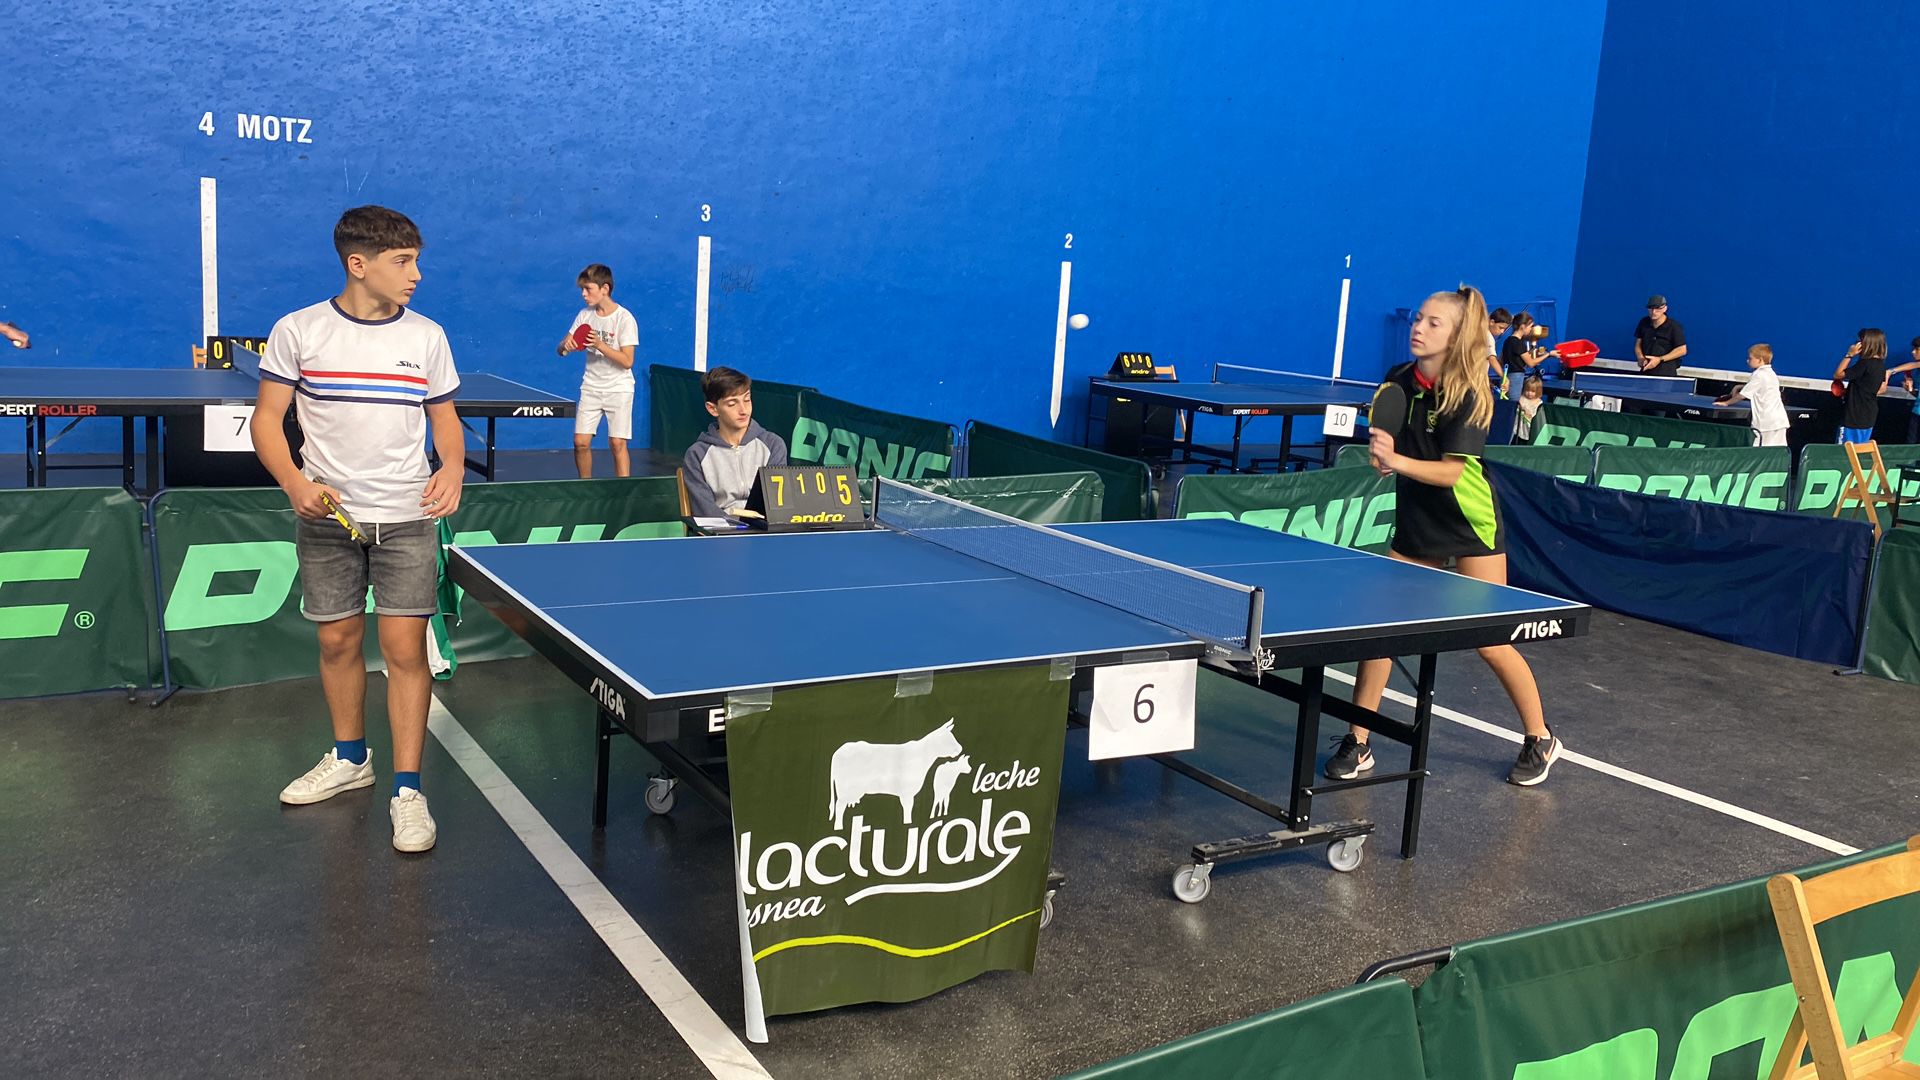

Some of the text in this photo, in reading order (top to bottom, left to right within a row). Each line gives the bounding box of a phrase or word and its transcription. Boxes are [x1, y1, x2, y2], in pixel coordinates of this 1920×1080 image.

[199, 111, 313, 144] 4 MOTZ
[700, 204, 712, 222] 3
[1064, 233, 1074, 249] 2
[1344, 254, 1351, 268] 1
[213, 340, 223, 359] 0
[38, 404, 97, 416] ROLLER
[512, 406, 554, 417] STIGA
[1333, 412, 1348, 427] 10
[233, 416, 247, 436] 7
[771, 472, 852, 506] 7 1 0 5
[790, 511, 846, 524] andro
[1510, 619, 1563, 641] STIGA
[590, 677, 626, 721] STIGA
[1132, 684, 1156, 724] 6
[971, 759, 1041, 794] leche
[739, 798, 1031, 896] lacturale
